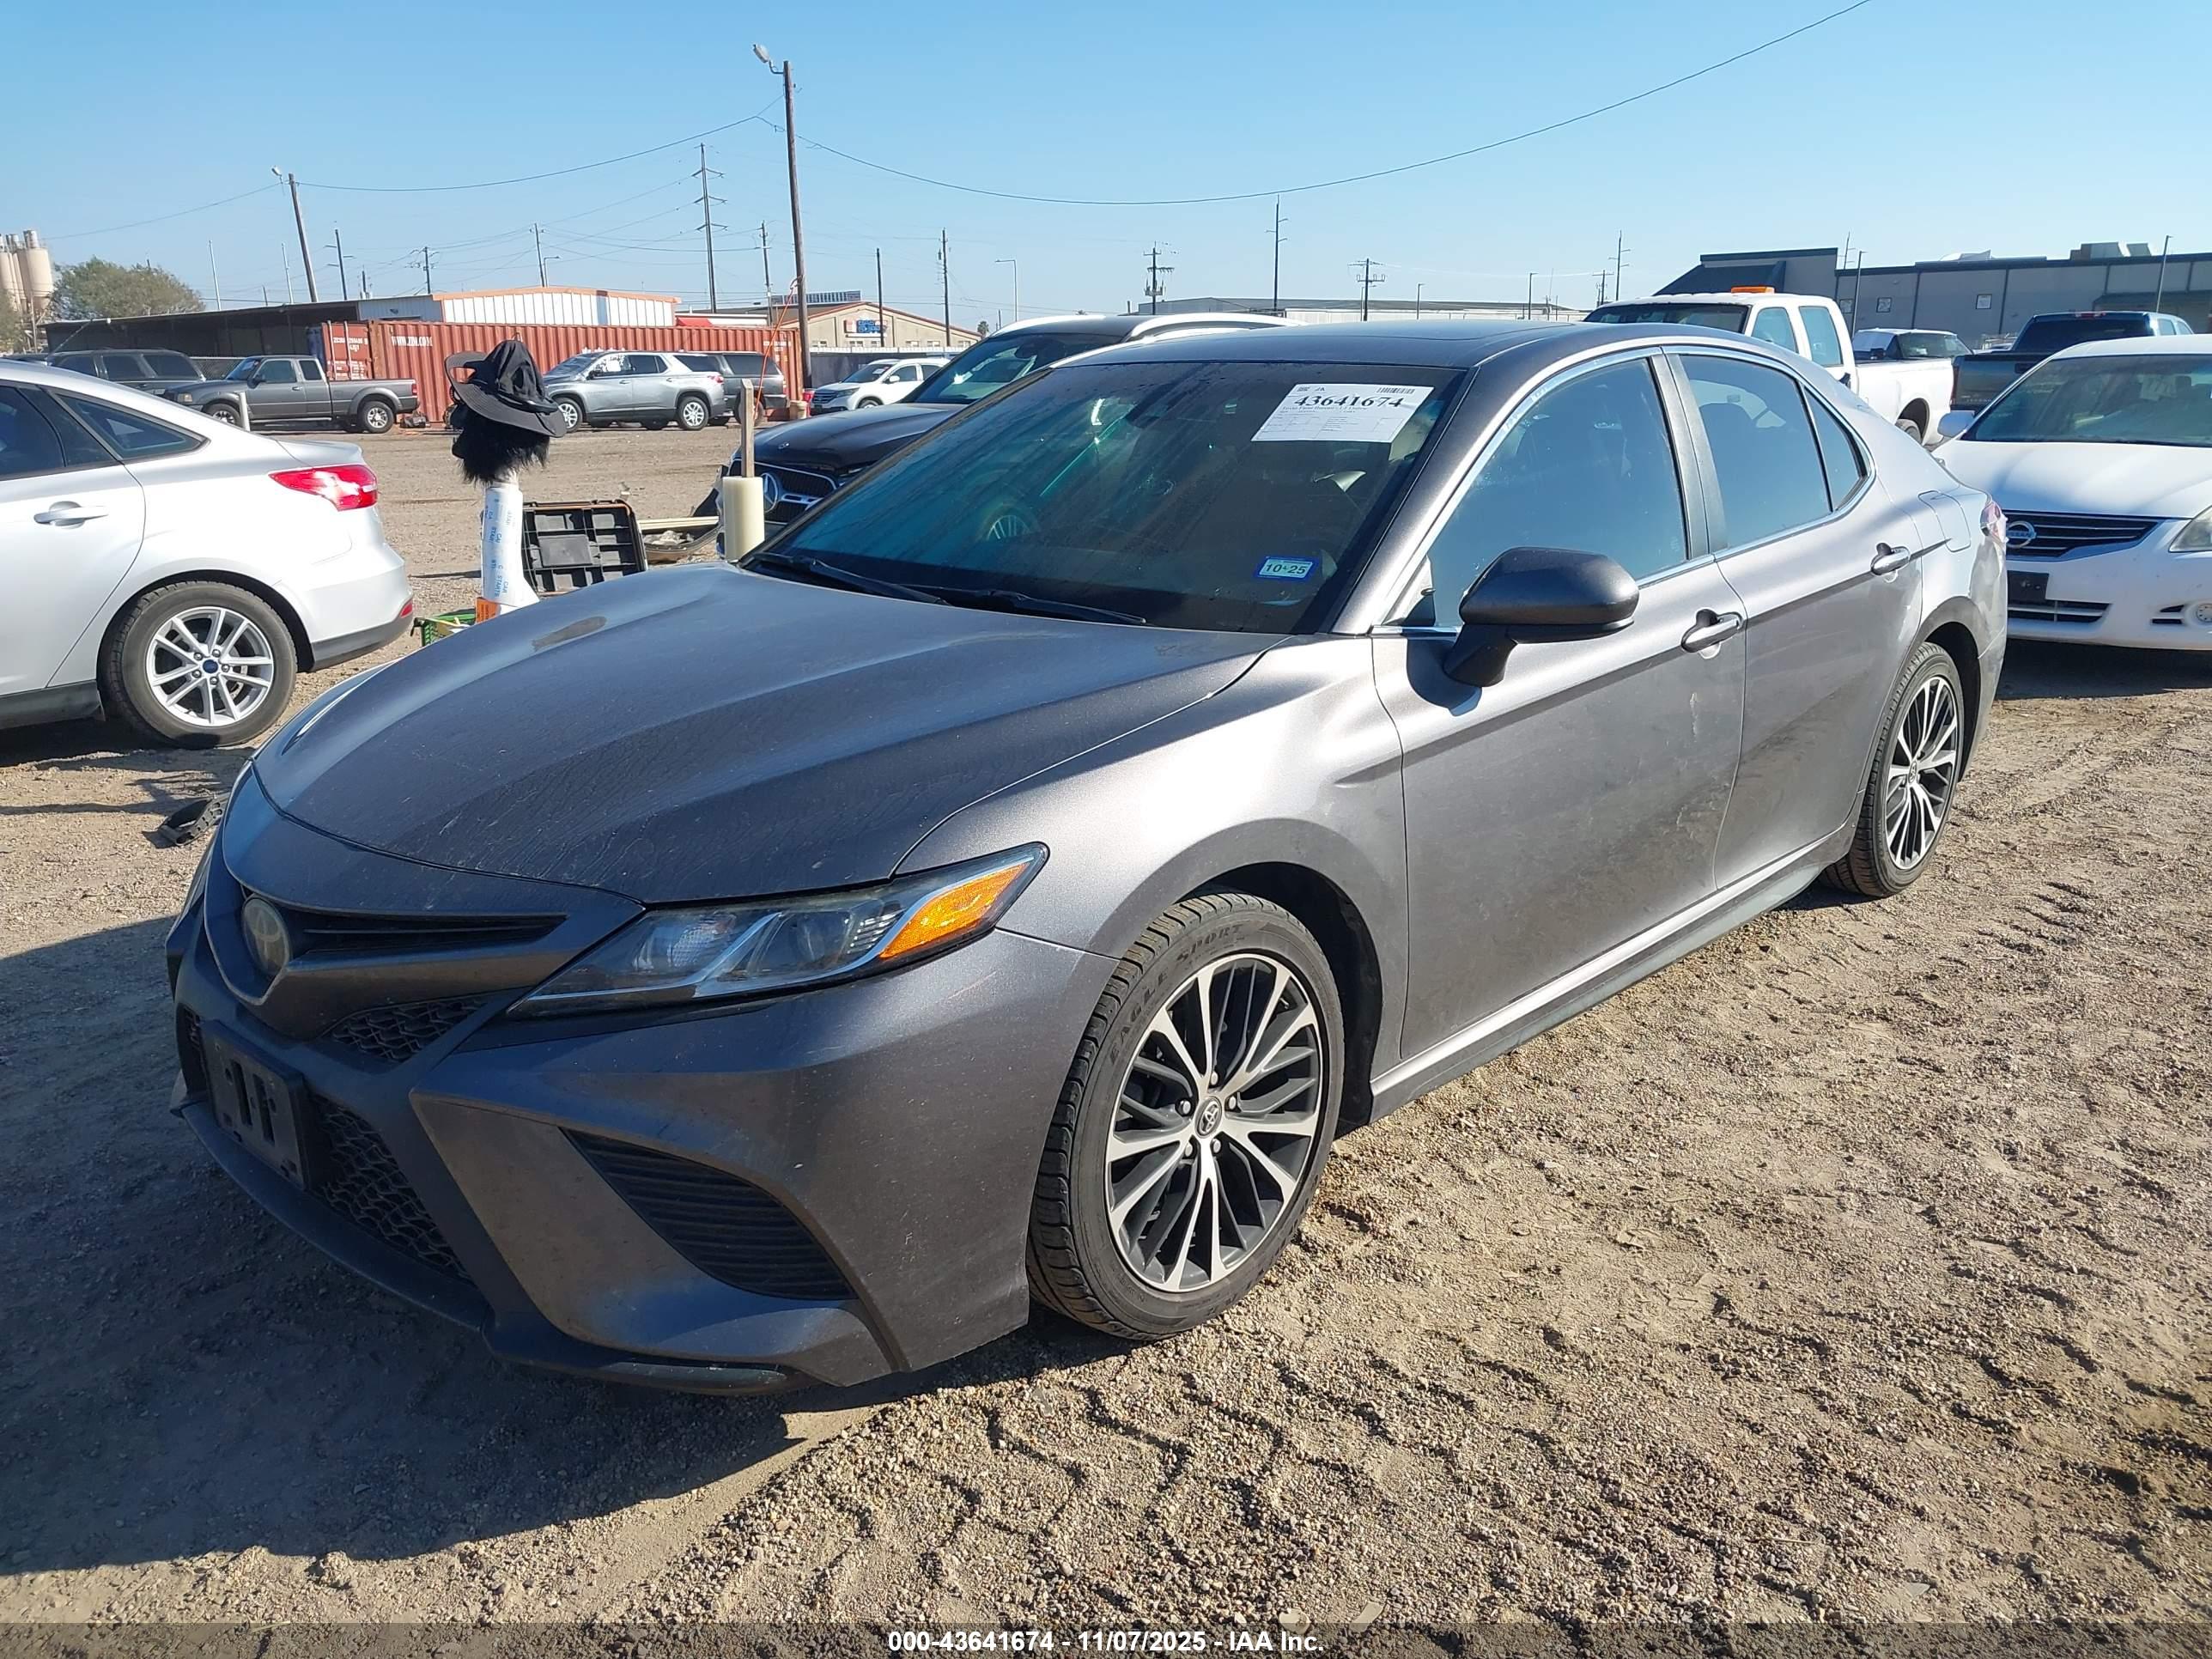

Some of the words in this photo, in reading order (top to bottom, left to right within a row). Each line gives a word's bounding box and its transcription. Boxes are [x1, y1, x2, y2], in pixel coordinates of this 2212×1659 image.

[1294, 395, 1403, 408] 43641674
[1109, 967, 1168, 1065] EAGLE
[1176, 923, 1243, 961] SPORT
